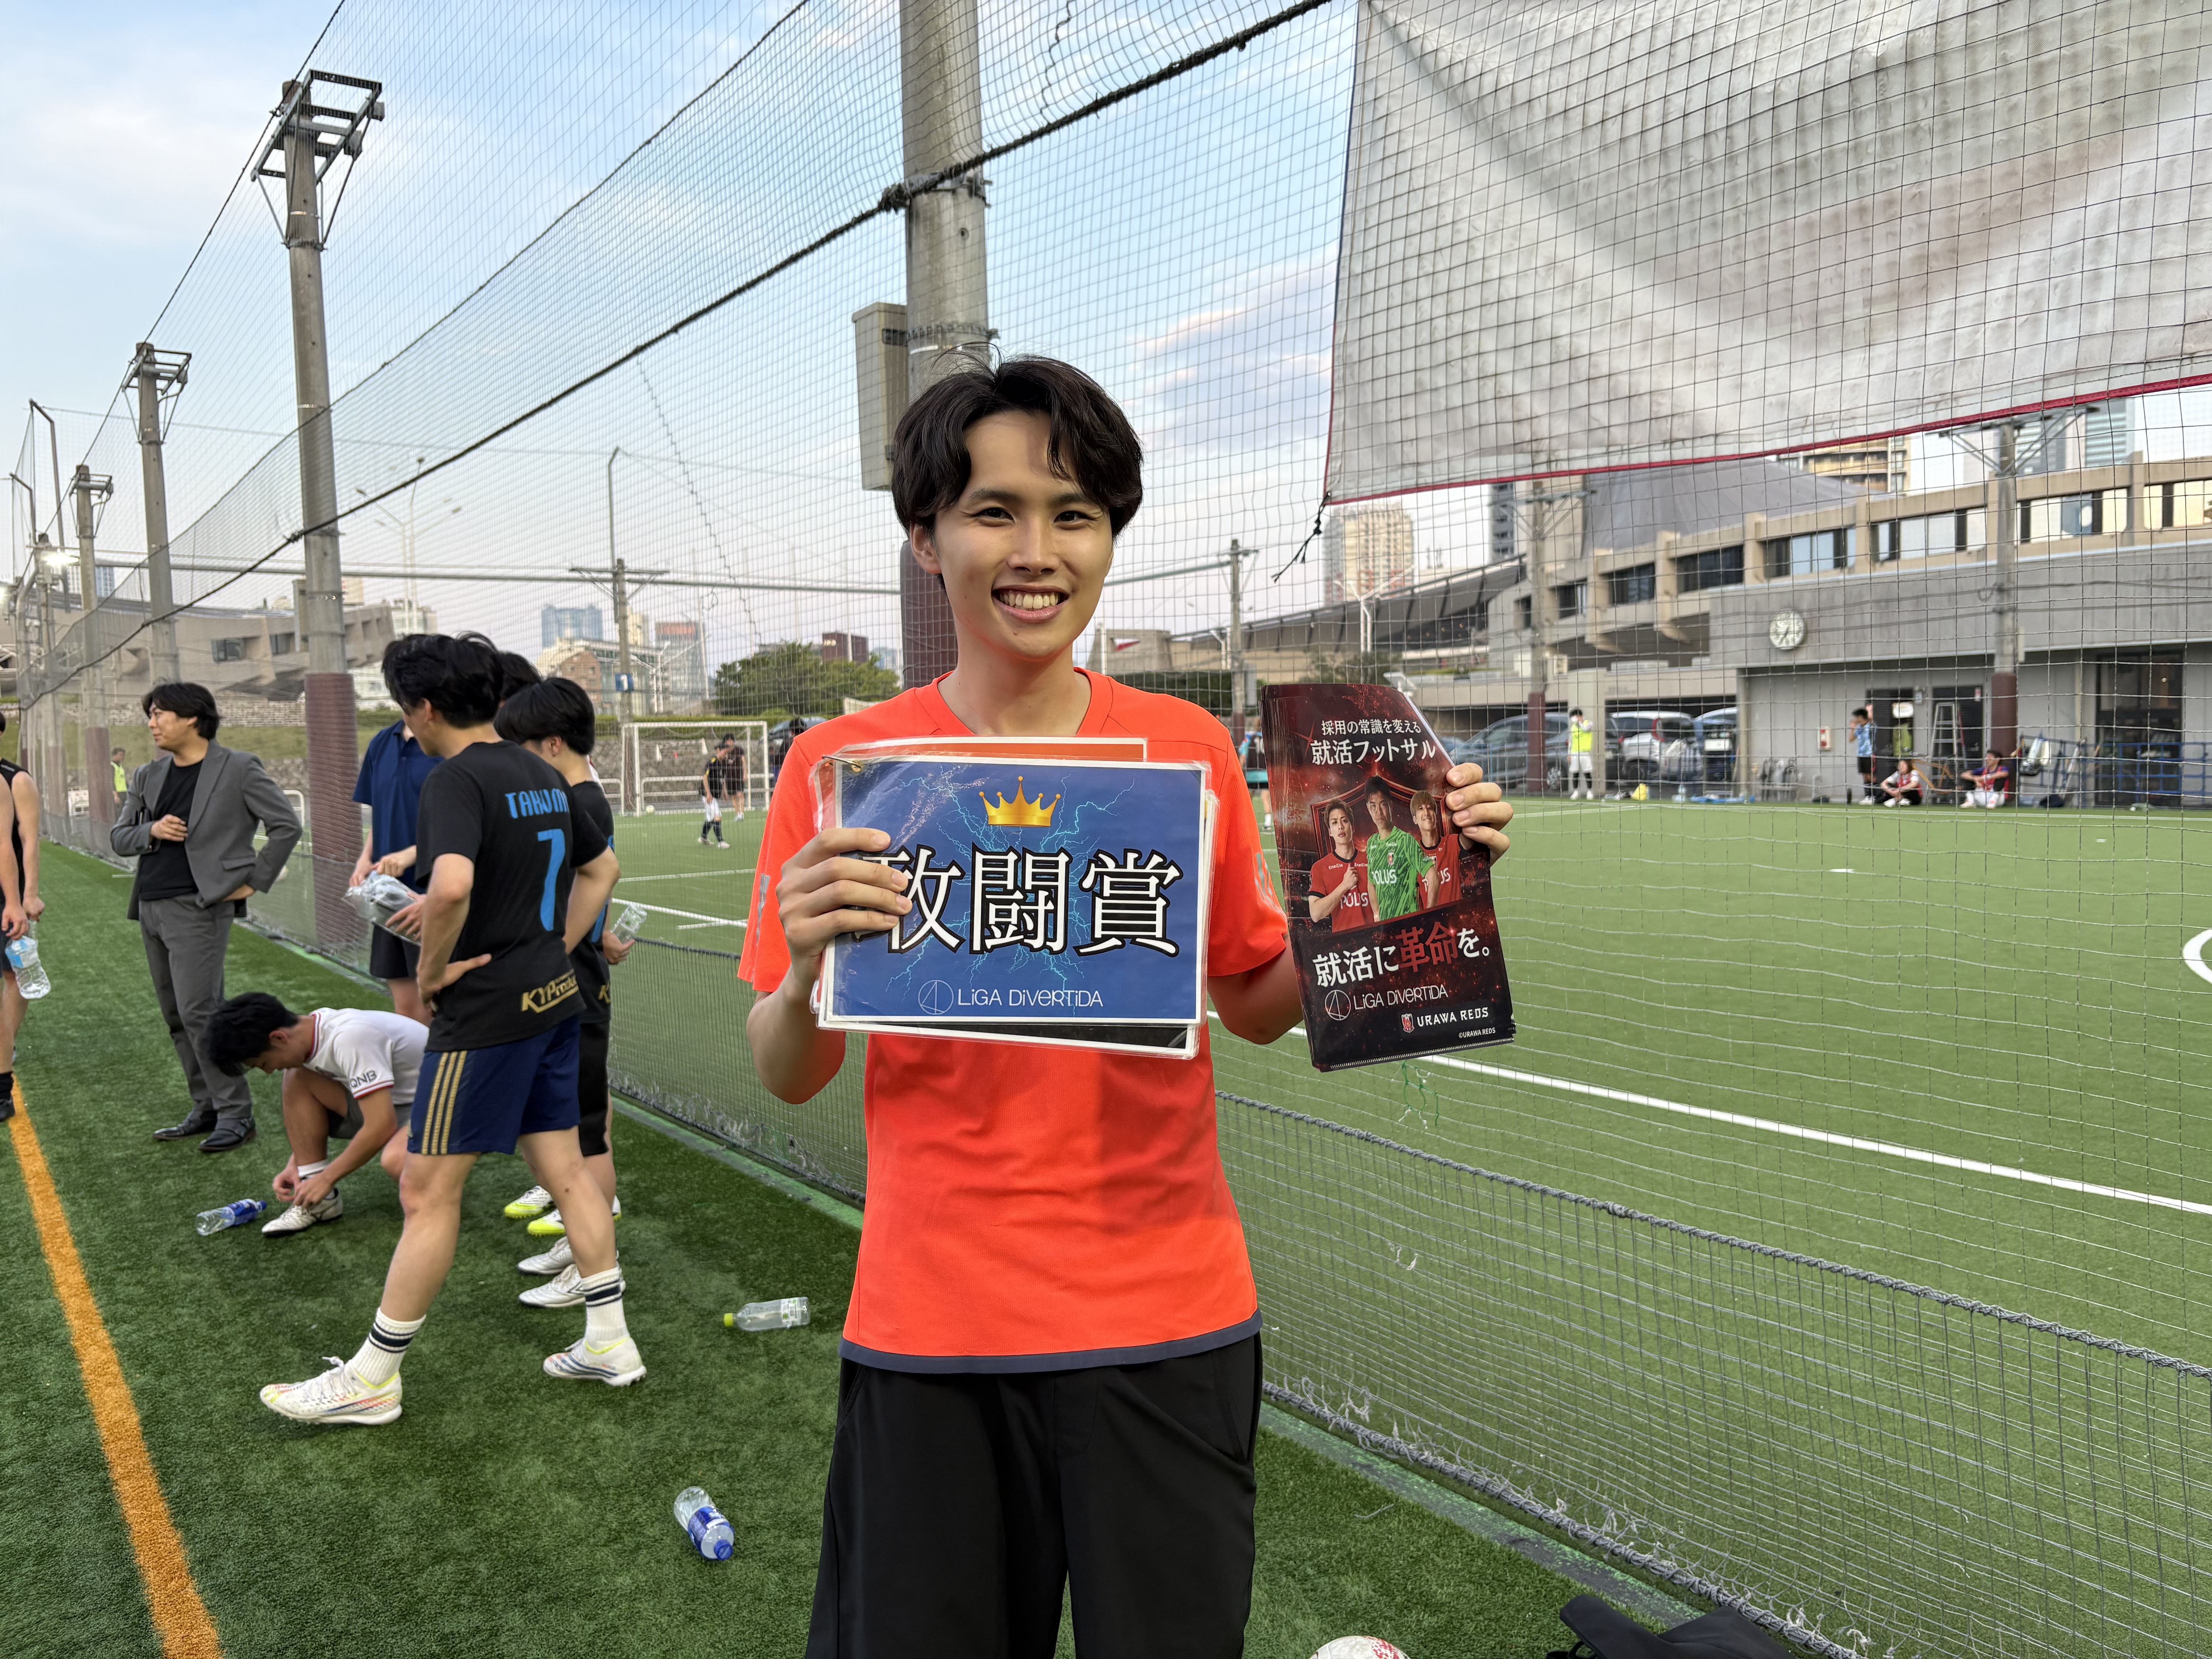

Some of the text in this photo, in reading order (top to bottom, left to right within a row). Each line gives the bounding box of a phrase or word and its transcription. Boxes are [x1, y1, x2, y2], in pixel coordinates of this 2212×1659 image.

[1321, 719, 1421, 735] 採用の常識を変える
[1310, 738, 1436, 765] 就活フットサル
[538, 828, 565, 932] 7
[852, 844, 1182, 956] 敢闘賞
[1312, 922, 1489, 987] 就活に革命を。
[1417, 1007, 1489, 1027] URAWA REDS
[350, 1070, 377, 1087] QNB
